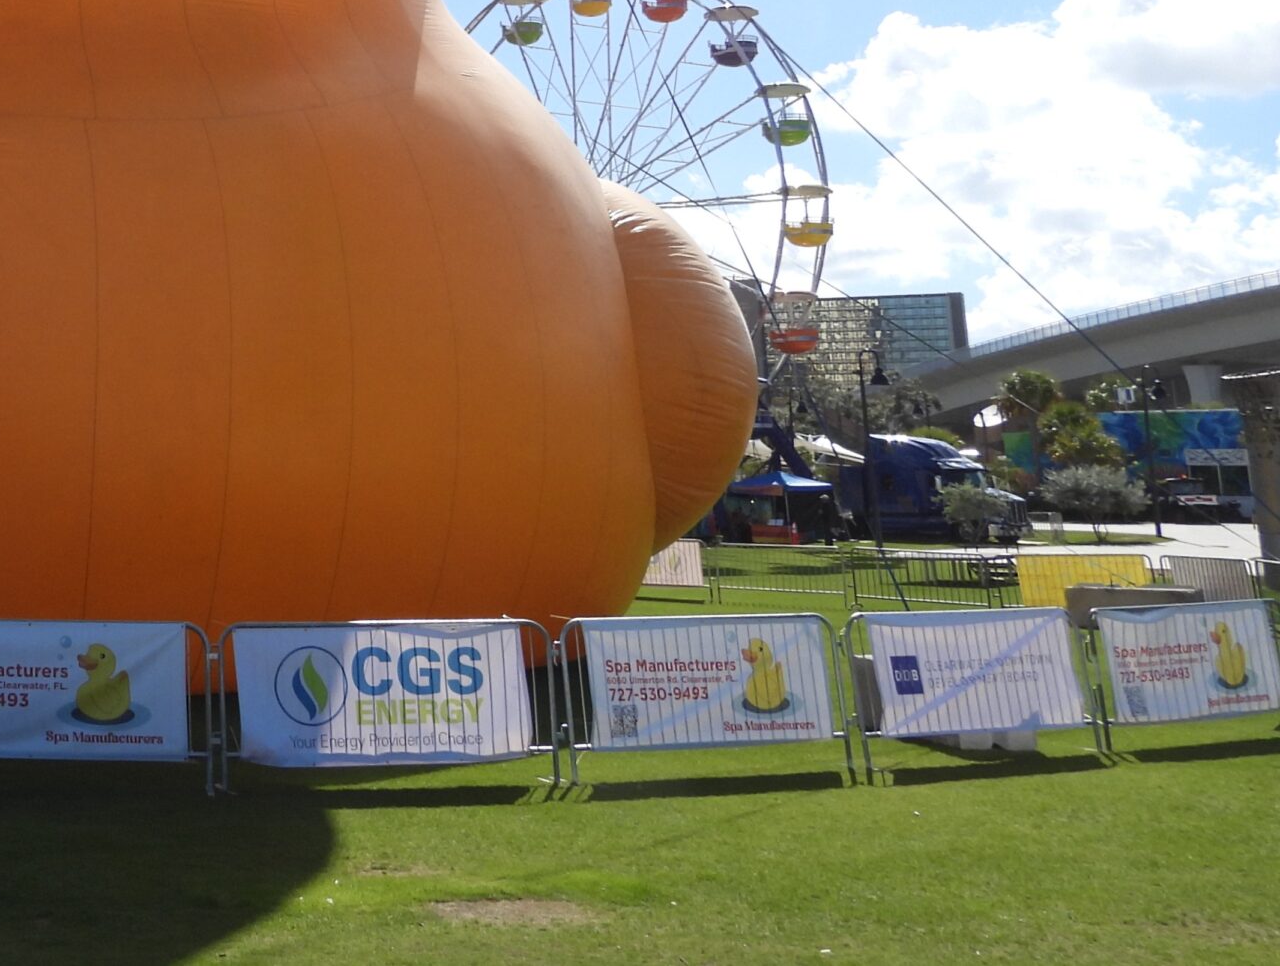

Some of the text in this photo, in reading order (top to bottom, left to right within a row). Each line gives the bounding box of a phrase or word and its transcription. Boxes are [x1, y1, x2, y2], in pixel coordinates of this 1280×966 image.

[1113, 643, 1208, 659] Spa Manufacturers
[351, 646, 484, 696] CGS
[605, 658, 736, 675] Spa Manufacturers
[894, 669, 920, 682] DDB
[1120, 667, 1190, 684] 727-530-9493
[609, 686, 709, 702] 727-530-9493
[355, 698, 484, 726] ENERGY
[723, 720, 816, 734] Spa Manufacturers
[45, 730, 164, 745] Spa Manufacturers
[289, 731, 484, 750] Your Energy Provider of Choice
